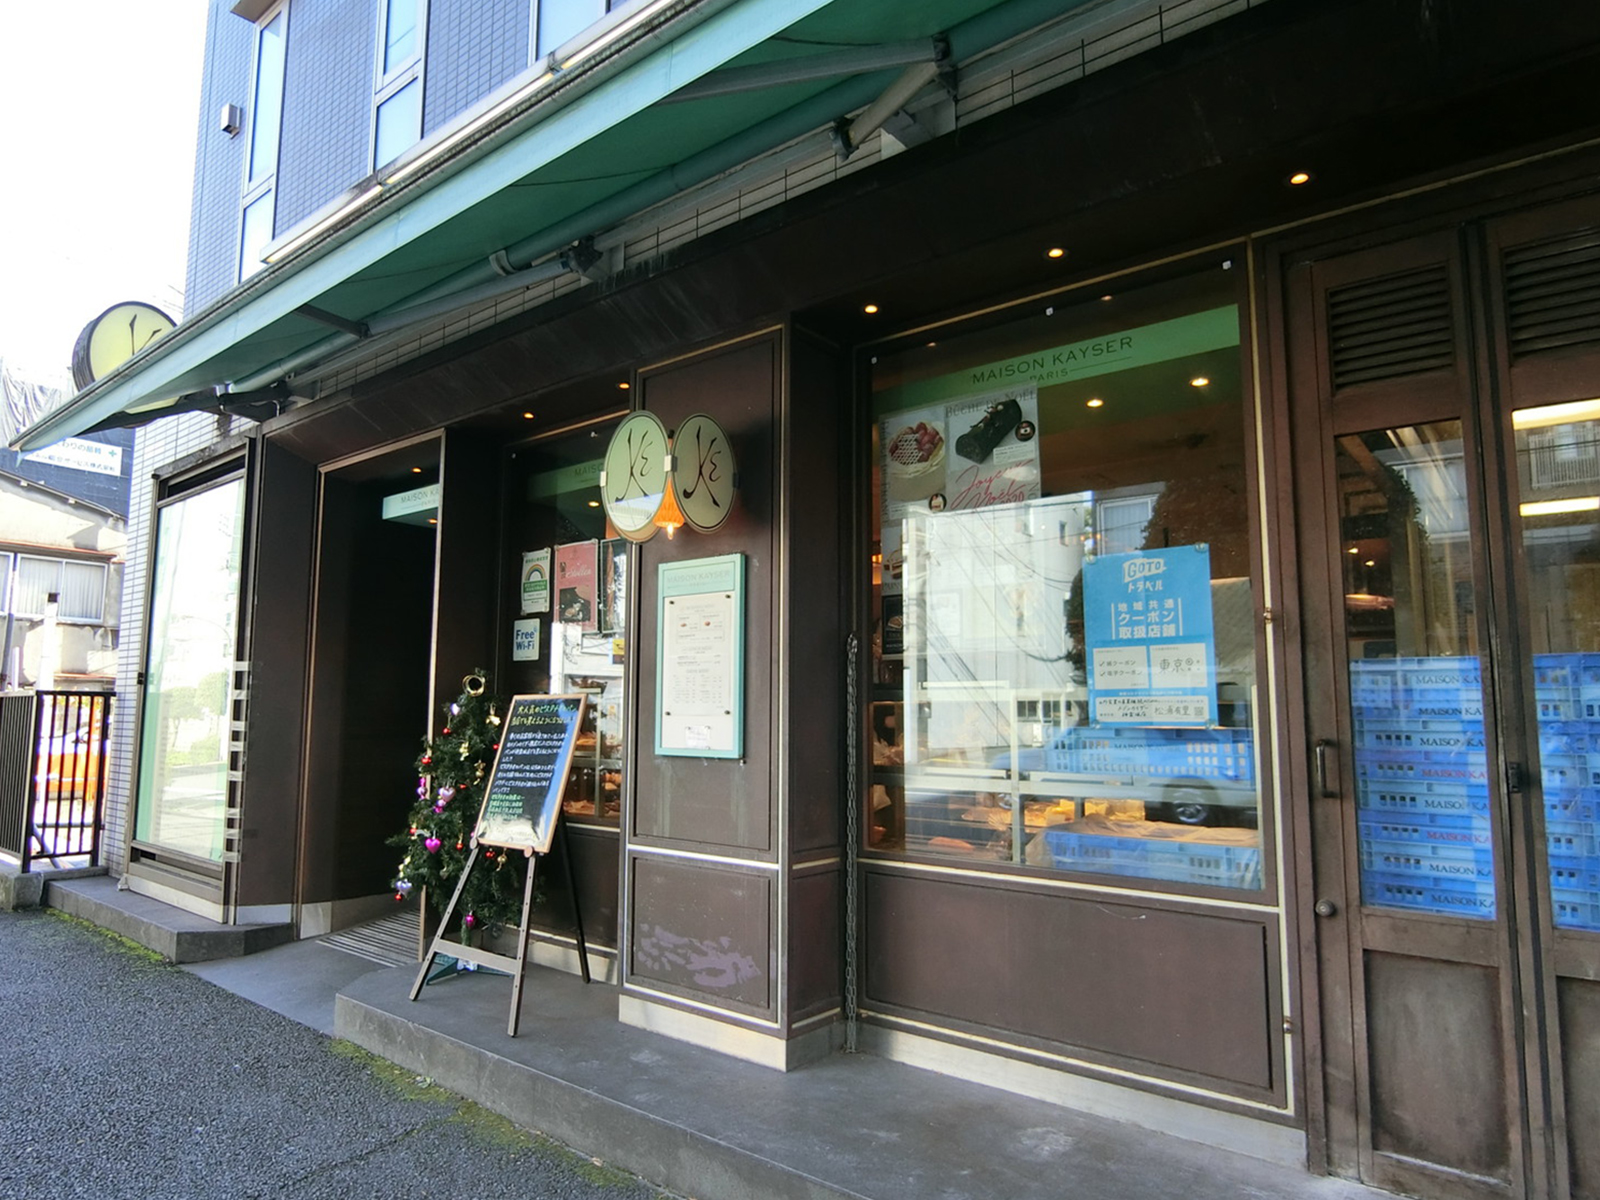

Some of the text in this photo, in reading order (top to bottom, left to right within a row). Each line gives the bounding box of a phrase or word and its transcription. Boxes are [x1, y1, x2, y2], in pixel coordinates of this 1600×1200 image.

[972, 335, 1133, 385] MAISON KAYSER
[1029, 367, 1069, 383] PARIS
[667, 570, 730, 583] MAISON KAYSER
[1127, 579, 1164, 594] トラベル
[1118, 598, 1175, 612] 地域共通
[1118, 611, 1175, 626] クーポン
[515, 629, 535, 640] Free
[1118, 625, 1177, 640] 取扱店舗
[515, 640, 535, 651] Wi-Fi
[1159, 658, 1185, 674] 東京
[1416, 675, 1459, 685] MAISON
[1418, 707, 1482, 717] MAISON KA
[1422, 768, 1466, 778] MAISON
[1424, 799, 1465, 810] MAISO
[1427, 831, 1472, 842] MAISON
[1429, 863, 1475, 875] MAISON
[1431, 894, 1477, 907] MAISON
